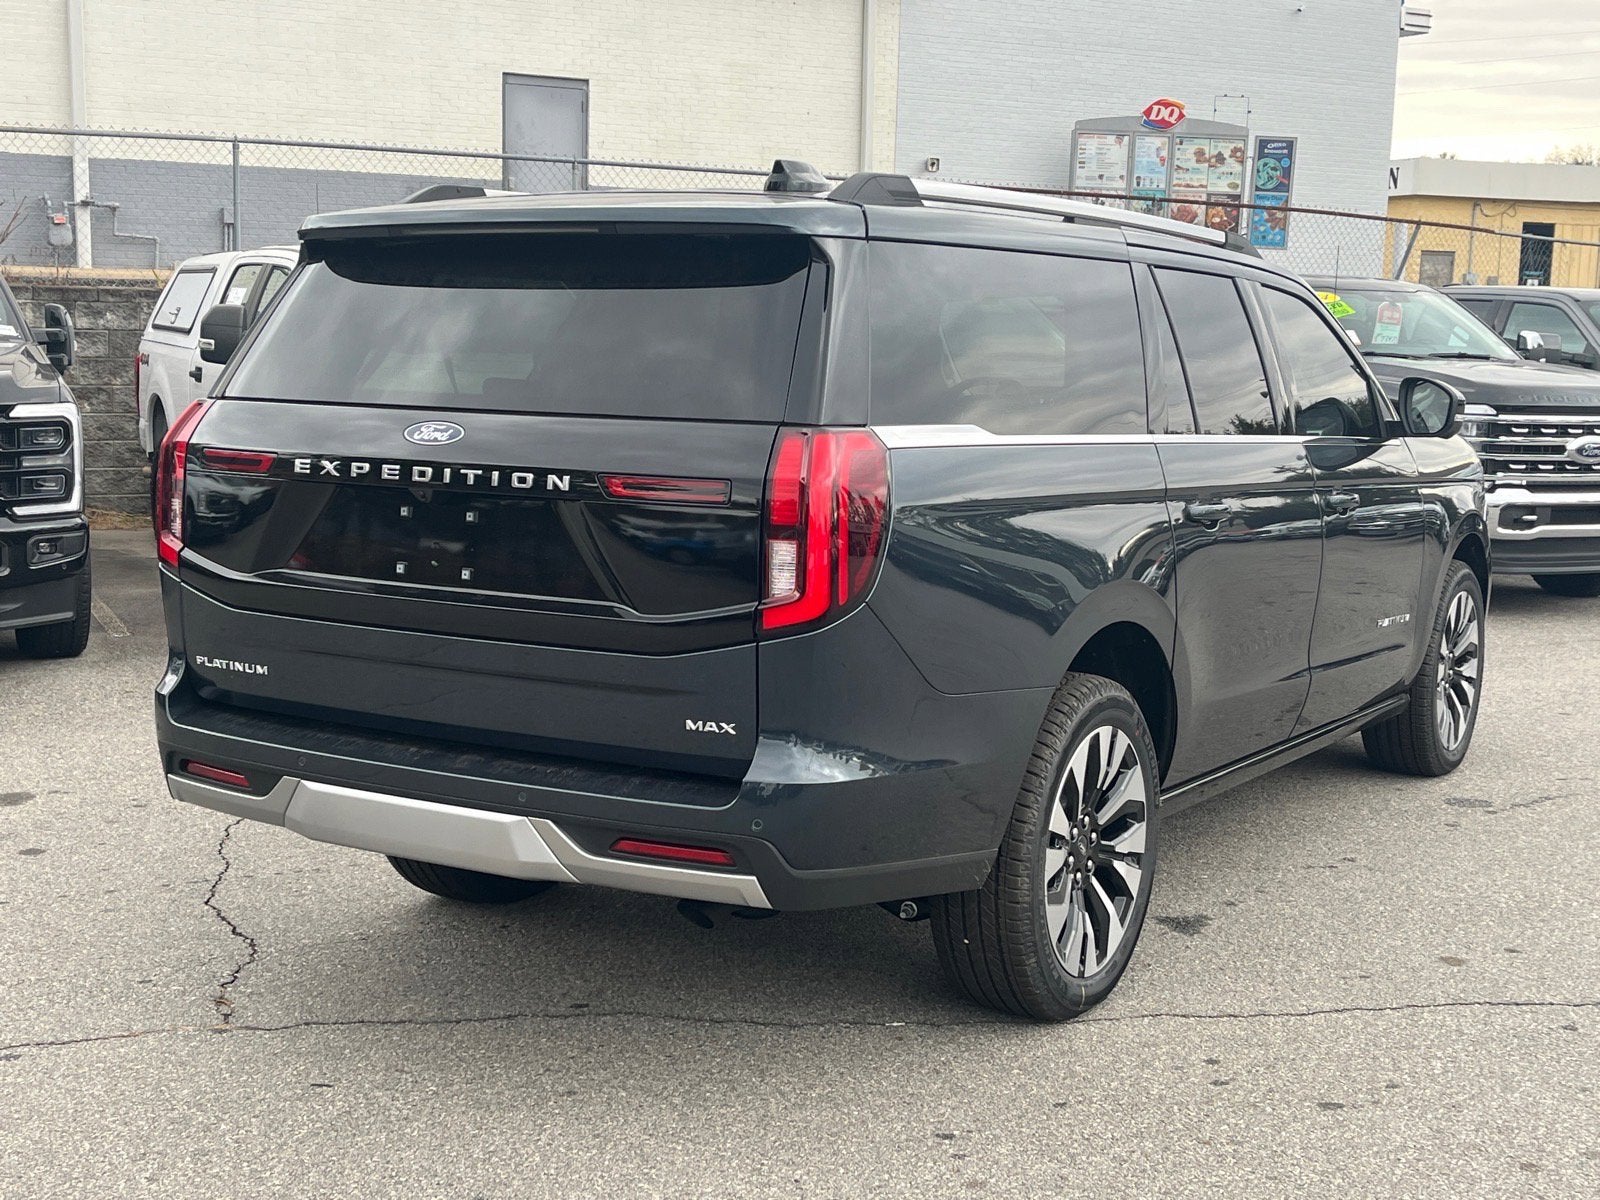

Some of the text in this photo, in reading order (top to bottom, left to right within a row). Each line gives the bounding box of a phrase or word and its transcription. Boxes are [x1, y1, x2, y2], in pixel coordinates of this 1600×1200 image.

[1149, 105, 1180, 124] DQ
[1388, 166, 1400, 190] N
[413, 424, 454, 441] Ford
[294, 458, 571, 491] EXPEDITION
[195, 655, 269, 676] PLATINUM
[685, 719, 737, 735] MAX
